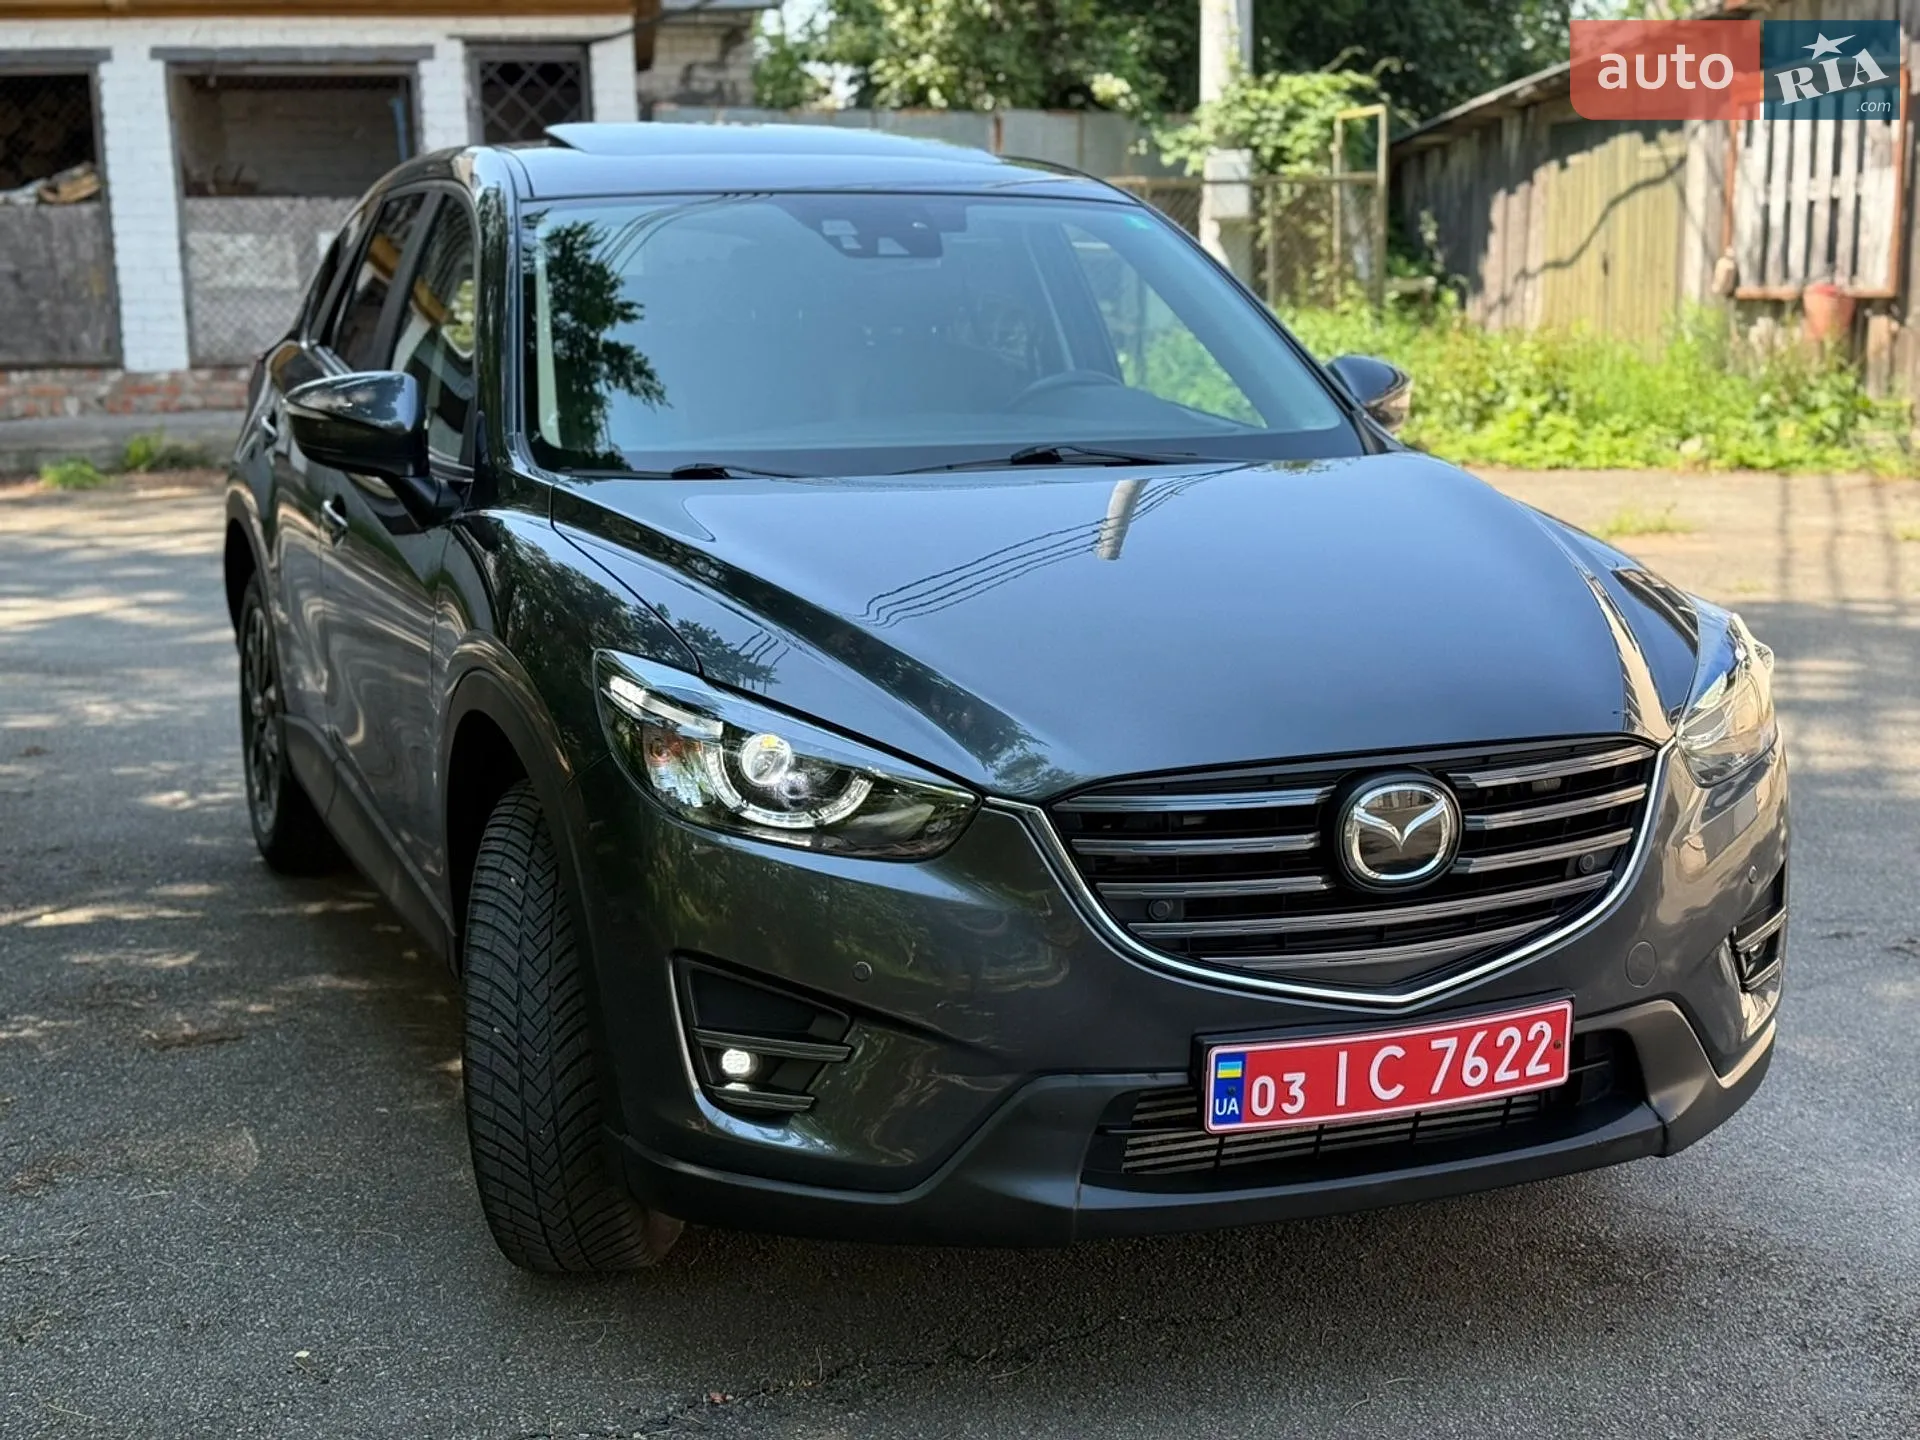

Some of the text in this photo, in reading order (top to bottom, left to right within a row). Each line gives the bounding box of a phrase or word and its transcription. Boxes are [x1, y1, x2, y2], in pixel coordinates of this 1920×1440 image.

[1250, 1071, 1306, 1116] 03
[1429, 1020, 1552, 1095] 7622
[1214, 1097, 1240, 1116] UA
